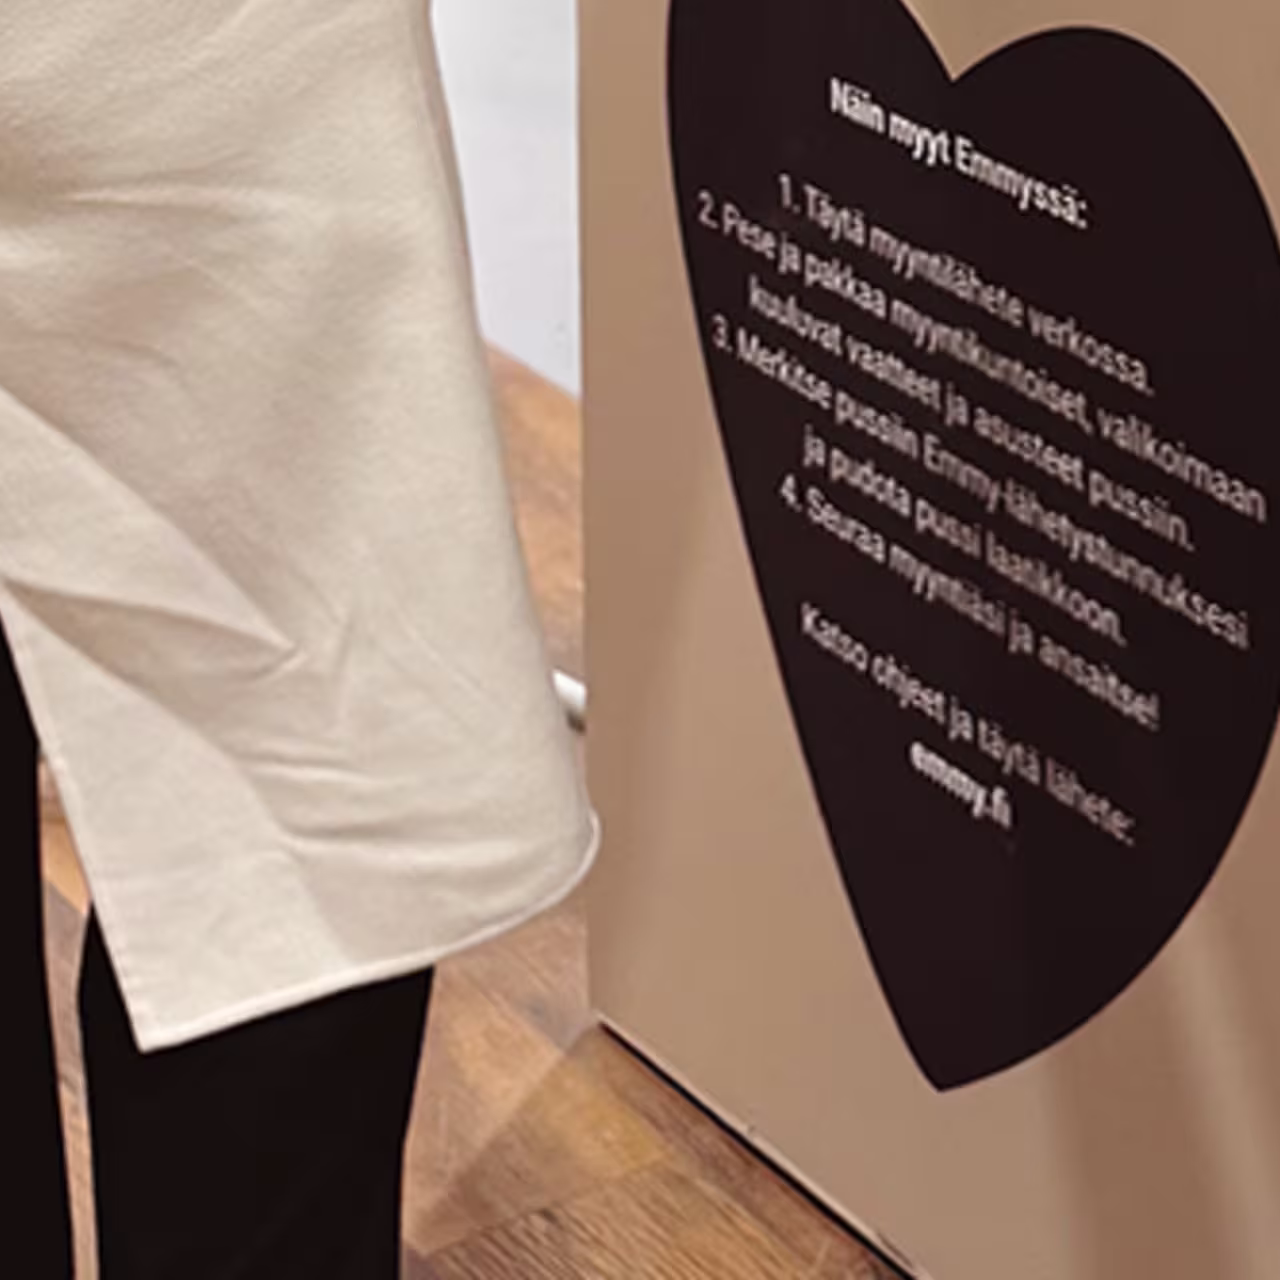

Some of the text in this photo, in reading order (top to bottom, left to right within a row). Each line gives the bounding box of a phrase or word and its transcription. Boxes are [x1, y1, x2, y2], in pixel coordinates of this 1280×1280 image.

[830, 75, 886, 134] Näin
[954, 135, 1089, 230] Emmyssä:
[697, 189, 719, 230] 2.
[723, 202, 776, 261] Pese
[778, 231, 801, 275] ja
[1096, 407, 1268, 523] valikoimaan
[711, 312, 733, 354] 3.
[778, 172, 802, 214] 1.
[1027, 304, 1156, 398] verkossa.
[803, 422, 826, 469] ja
[914, 498, 982, 560] pussi
[944, 381, 969, 428] ja
[973, 405, 1085, 492] asusteet
[1087, 469, 1197, 553] pussiin.
[780, 471, 804, 514] 4.
[806, 485, 887, 565] Seuraa
[1007, 607, 1035, 655] ja
[799, 600, 870, 673] Katso
[947, 693, 975, 742] ja
[907, 739, 1015, 829] emmy.fi
